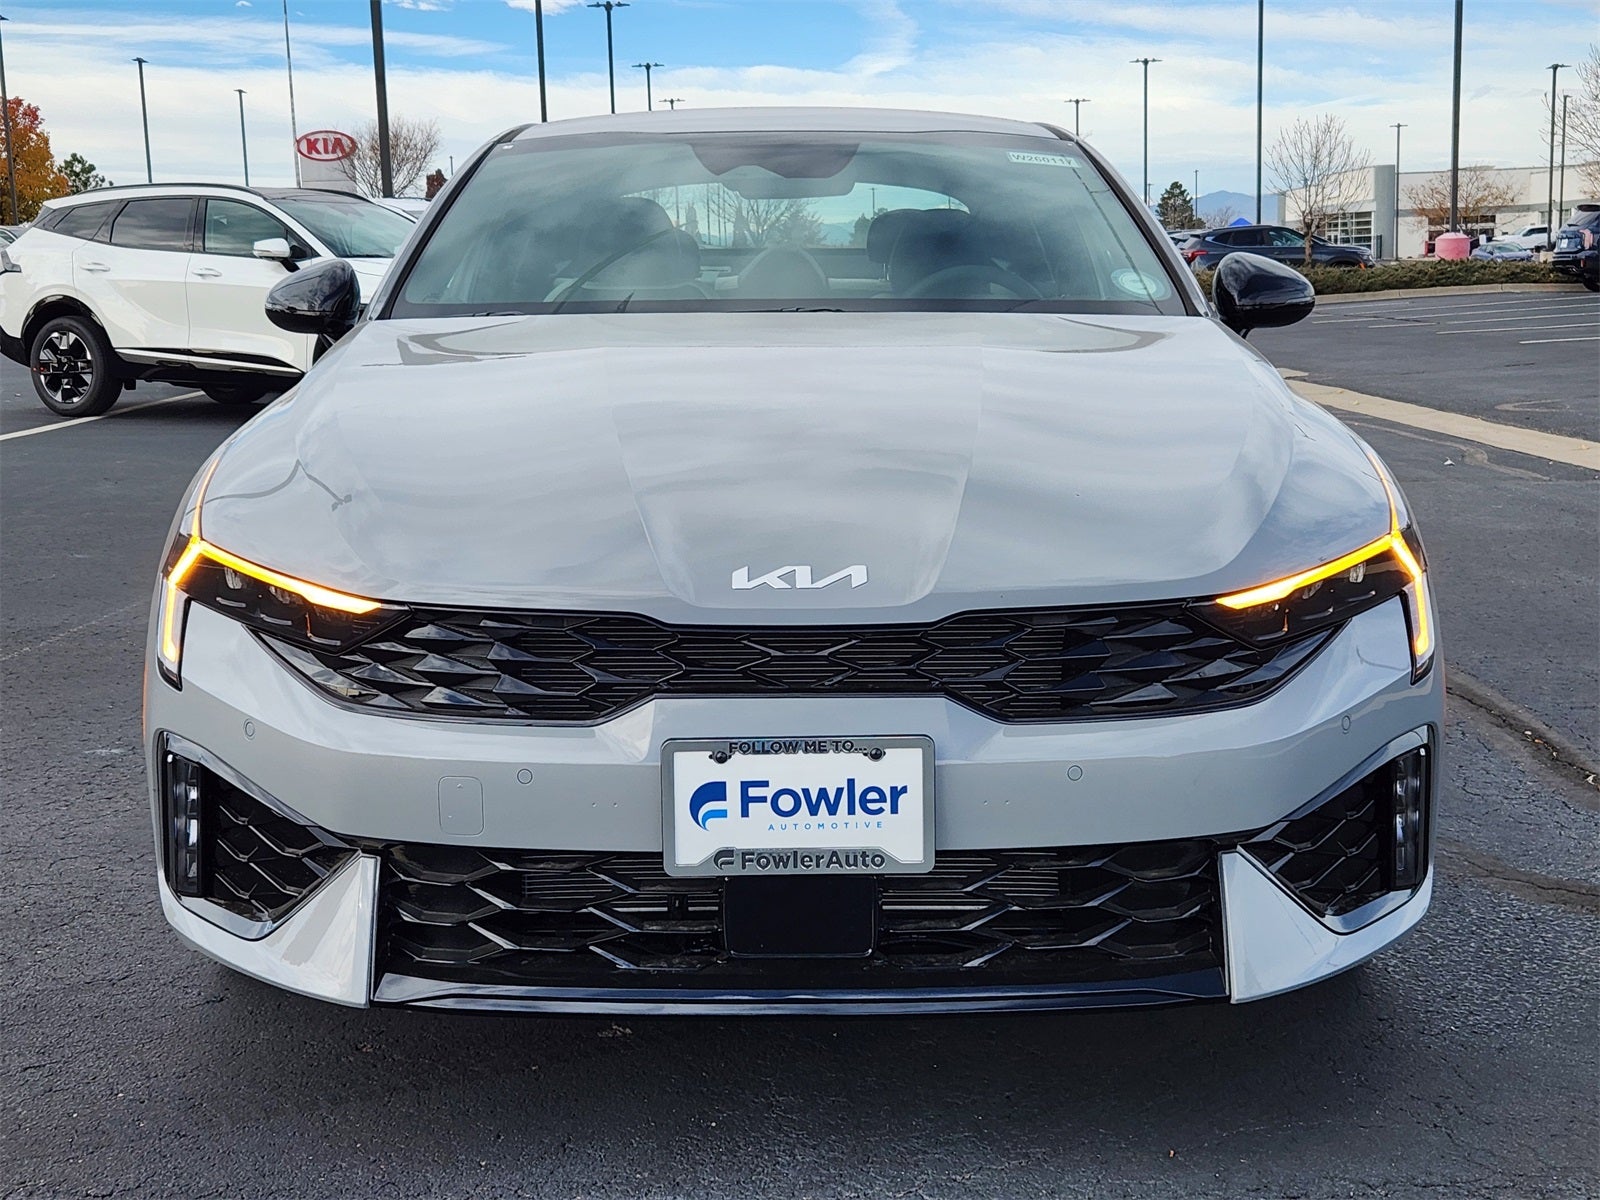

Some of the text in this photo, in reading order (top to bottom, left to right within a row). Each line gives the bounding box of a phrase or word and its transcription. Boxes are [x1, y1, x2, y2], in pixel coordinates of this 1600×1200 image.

[305, 137, 348, 156] KIA
[729, 740, 799, 754] FOLLOW
[804, 740, 827, 753] ME
[740, 778, 908, 818] Fowler
[767, 821, 883, 831] AUTOMOTIVE
[741, 850, 886, 870] FowlerAuto
